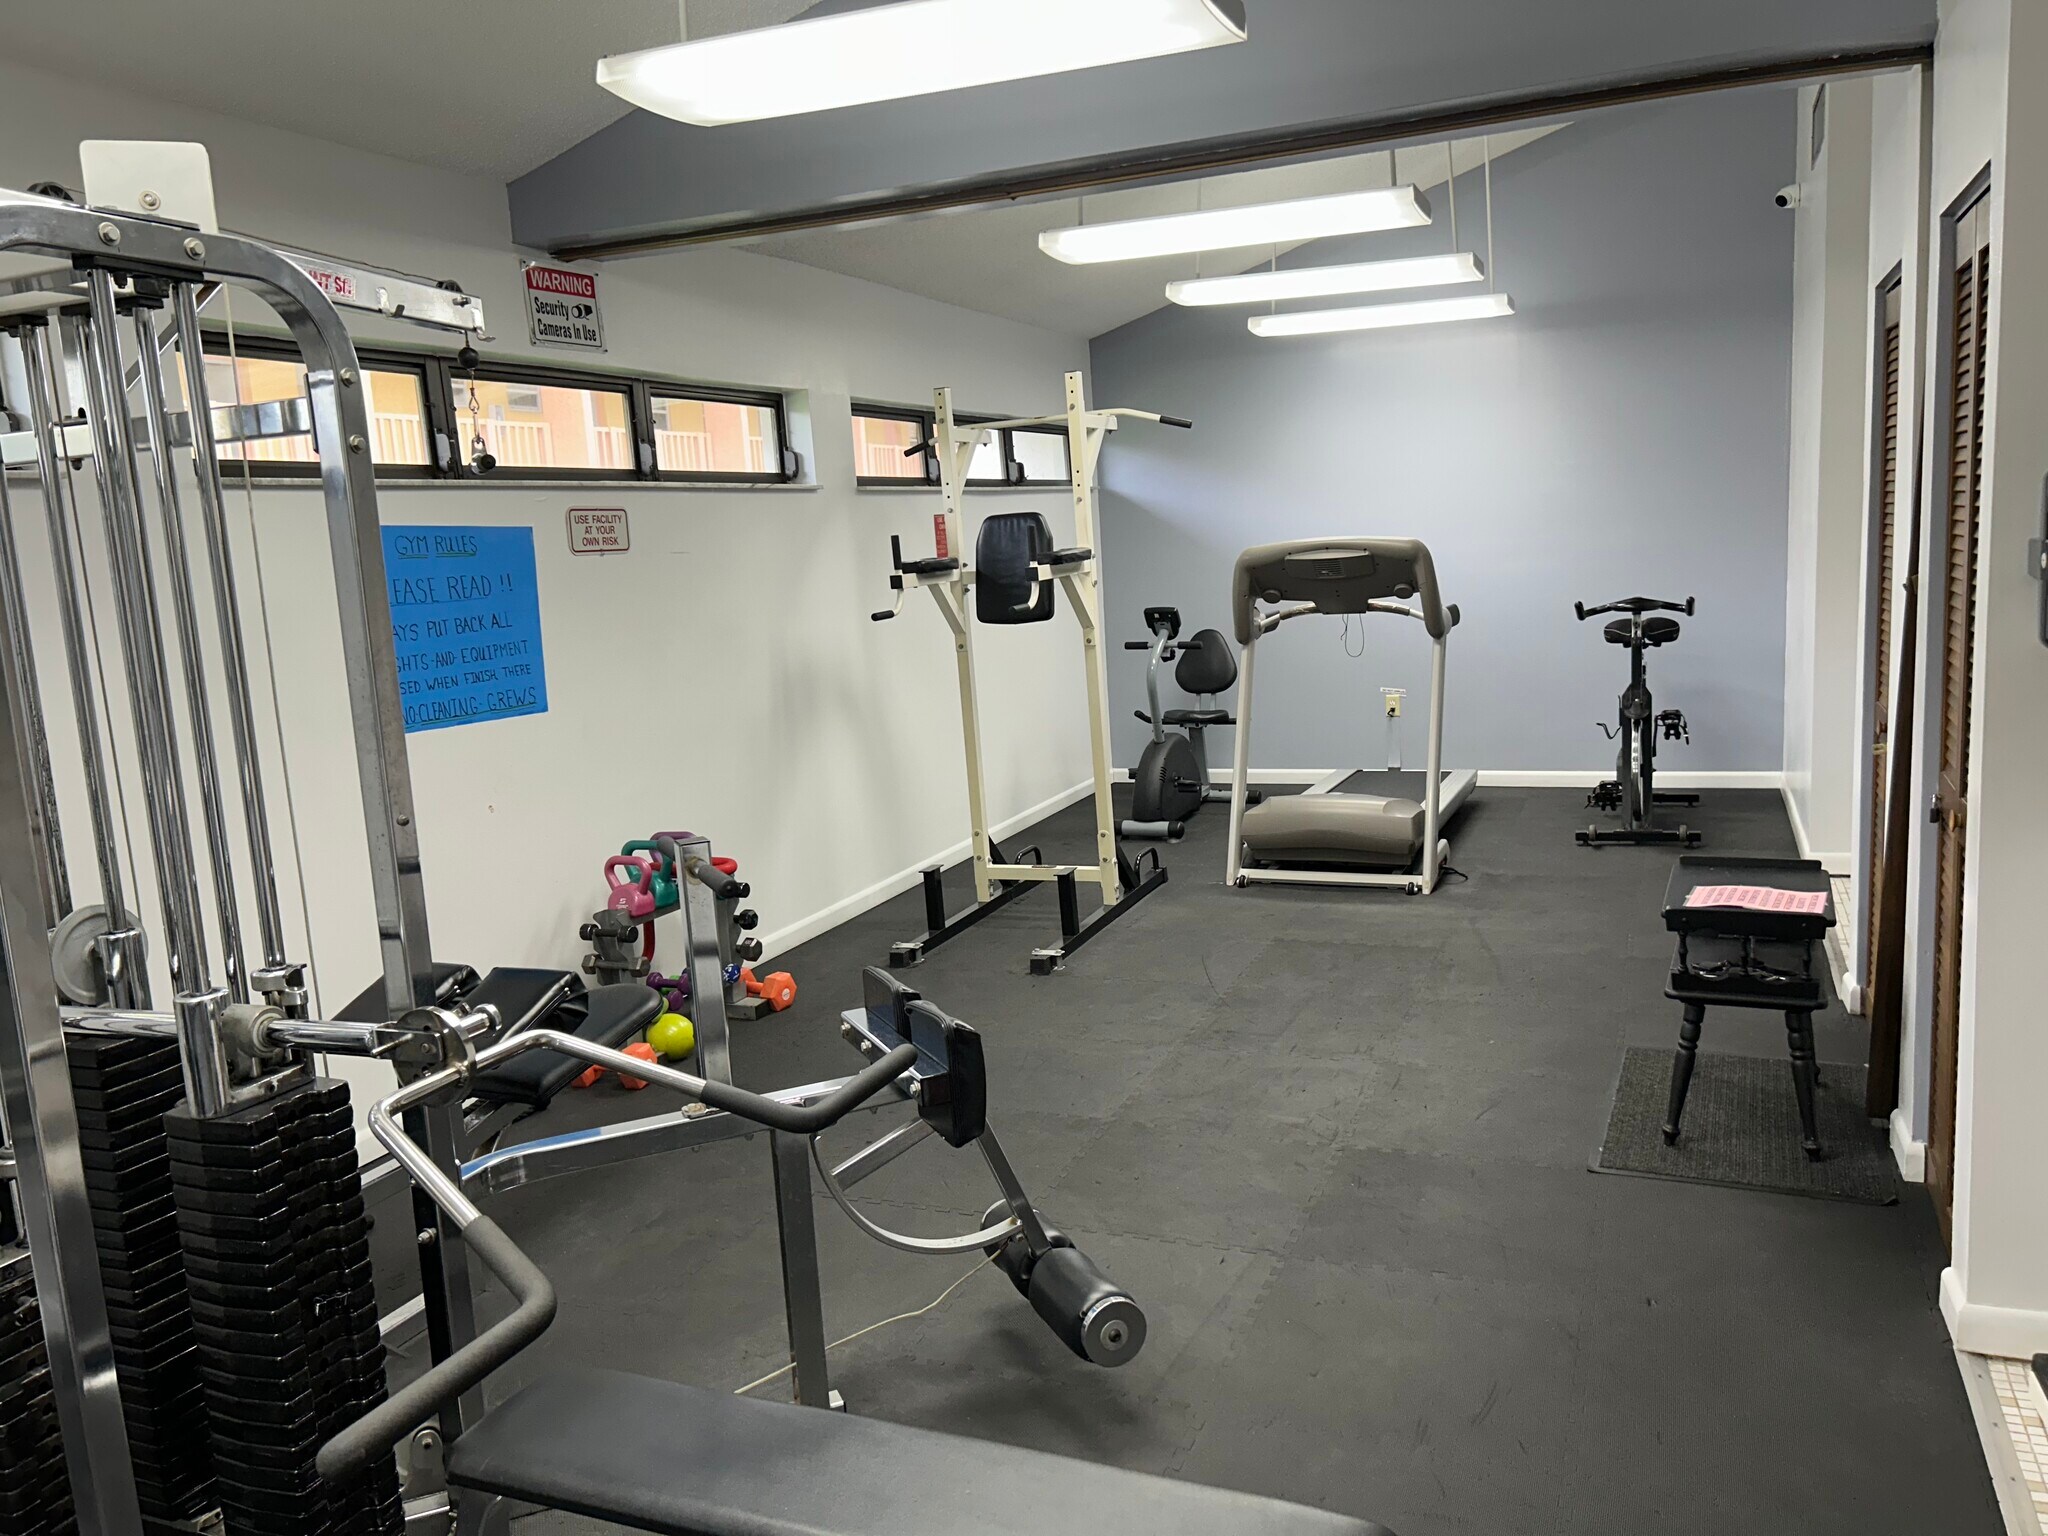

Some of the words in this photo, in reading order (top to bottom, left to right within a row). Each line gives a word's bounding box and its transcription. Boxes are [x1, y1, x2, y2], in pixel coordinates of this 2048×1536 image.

[529, 269, 593, 296] WARNING
[534, 296, 569, 321] Security
[537, 318, 572, 339] Cameras
[573, 323, 582, 340] In
[582, 323, 597, 342] Use
[574, 514, 590, 524] USE
[592, 514, 622, 524] FACILITY
[584, 525, 593, 535] AT
[595, 525, 616, 535] YOUR
[394, 535, 430, 556] GYM
[434, 535, 478, 553] RULES
[582, 537, 600, 547] OWN
[602, 536, 620, 546] RISK
[391, 577, 440, 605] EASE
[446, 575, 492, 601] READ
[426, 619, 449, 638] PUT
[454, 614, 488, 635] BACK
[491, 611, 513, 629] ALL
[460, 639, 528, 664] EQUIPMENT
[399, 680, 421, 695] SED
[424, 674, 459, 691] WHEN
[463, 669, 499, 685] FINISH
[501, 664, 532, 678] THERE
